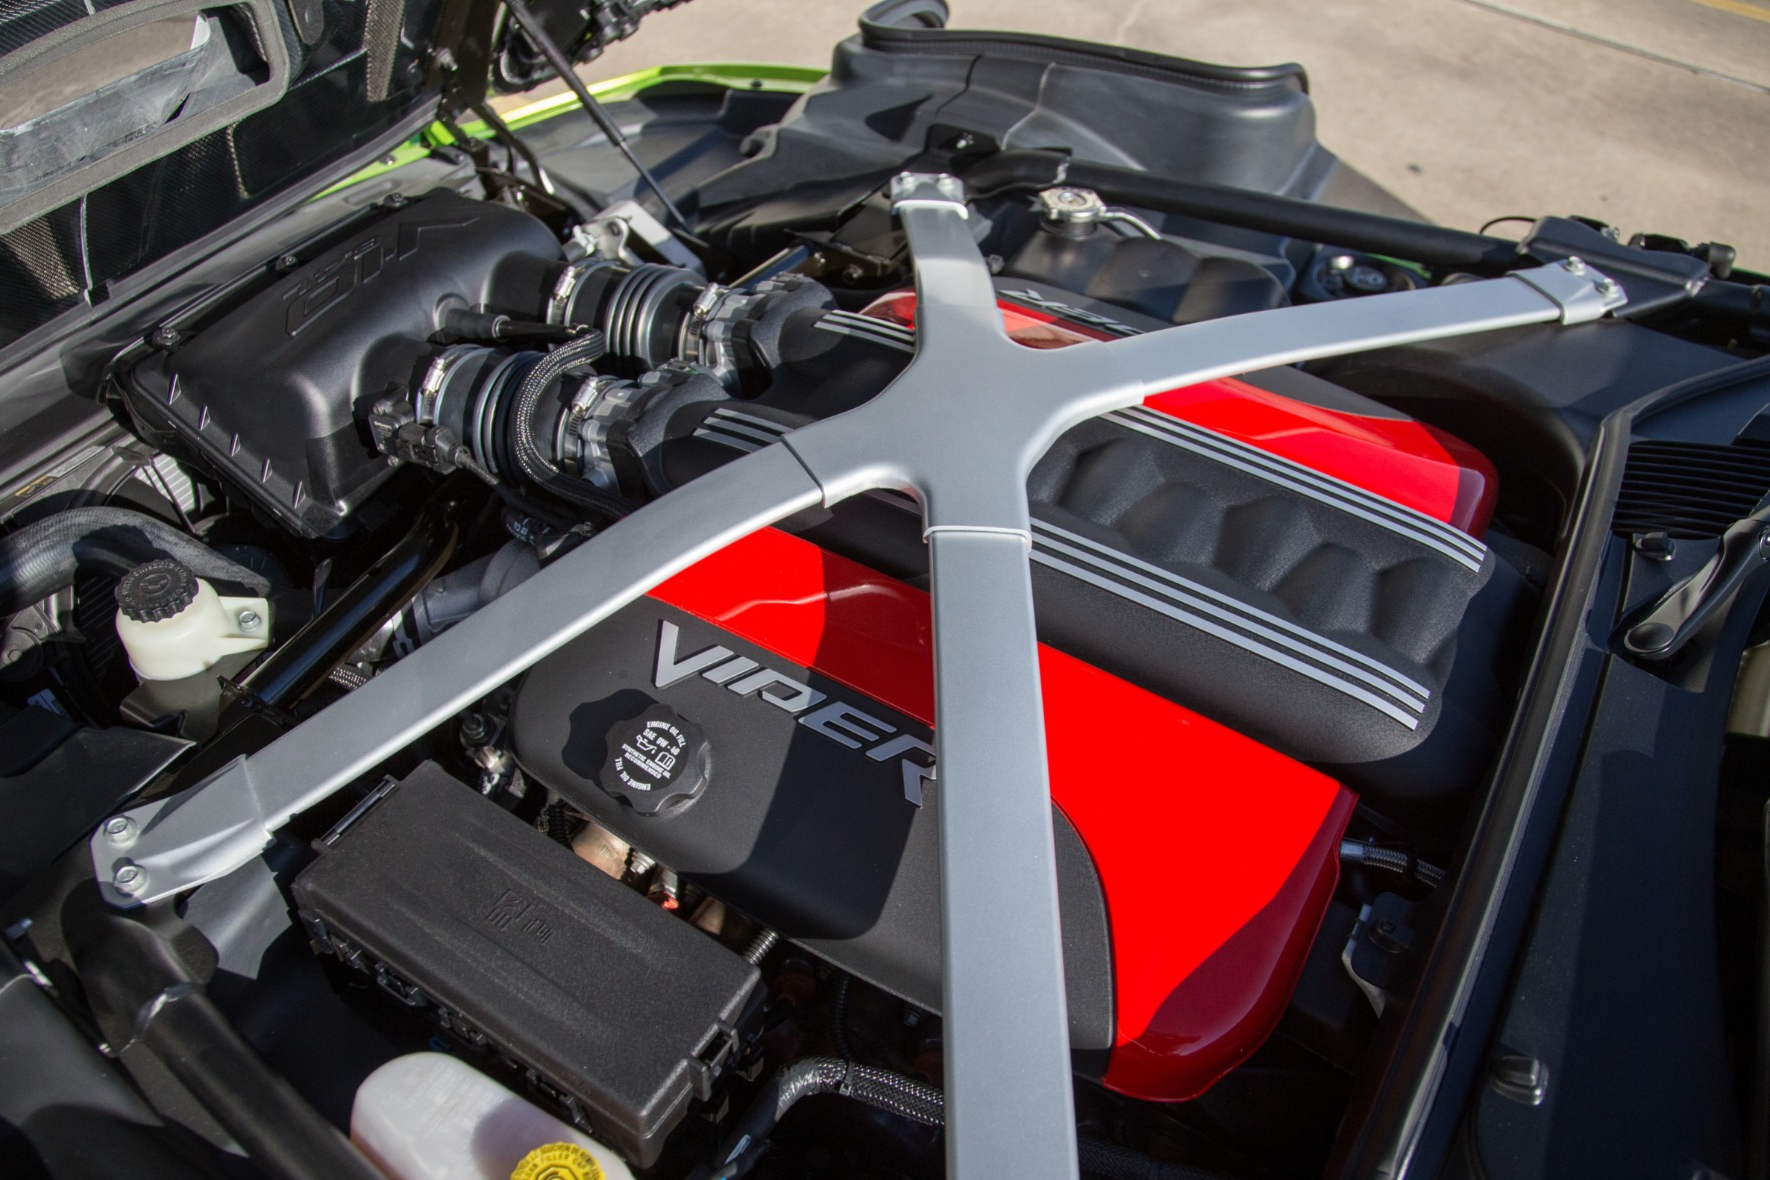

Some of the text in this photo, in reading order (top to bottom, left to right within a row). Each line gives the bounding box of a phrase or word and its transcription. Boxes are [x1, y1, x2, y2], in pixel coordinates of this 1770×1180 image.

[654, 619, 937, 809] VIPER
[643, 728, 657, 741] SAE
[647, 721, 686, 748] ENGINE OIL FILL
[615, 757, 651, 791] ENGINE OIL FILL
[621, 743, 647, 762] SYNTHETIC
[662, 770, 672, 779] OIL
[624, 752, 662, 779] RECOMMENDED
